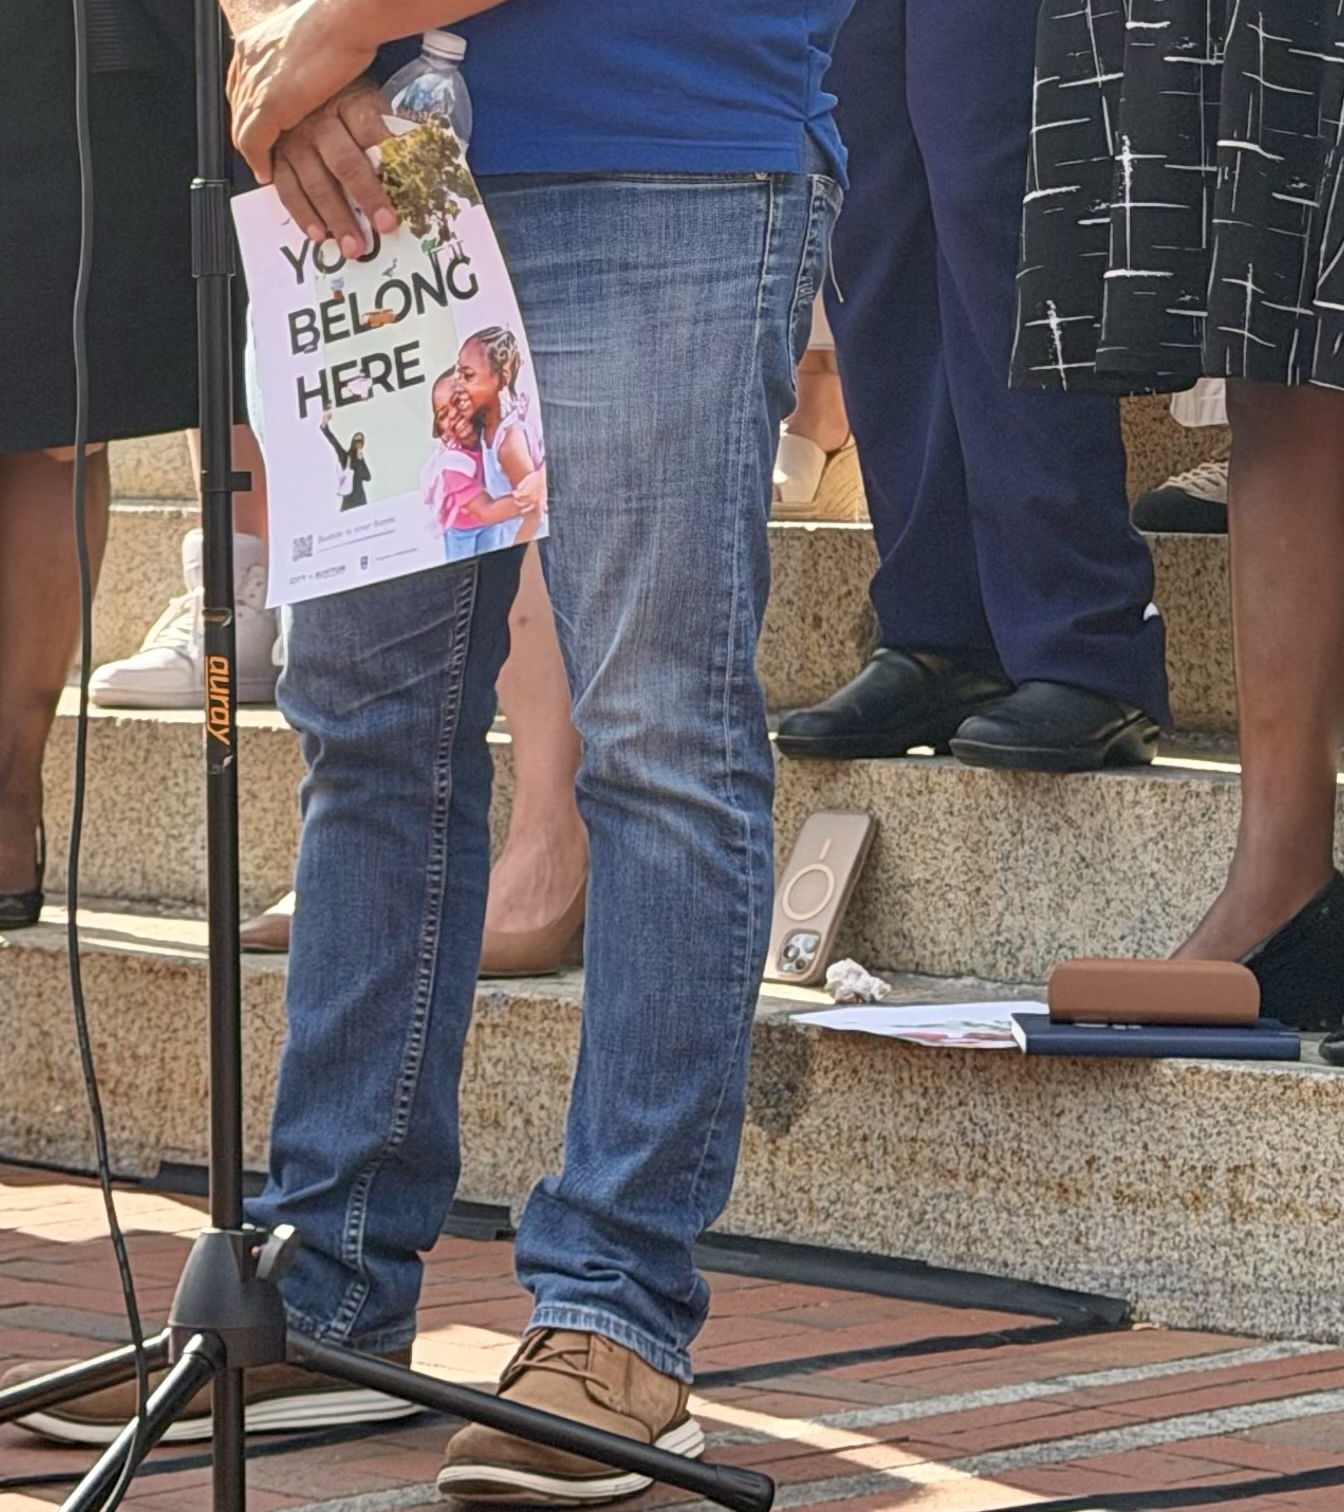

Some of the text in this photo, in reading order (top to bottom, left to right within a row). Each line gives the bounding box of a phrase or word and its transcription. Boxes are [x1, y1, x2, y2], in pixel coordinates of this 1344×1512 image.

[280, 231, 381, 285] YOU
[288, 252, 479, 355] BELONG
[296, 340, 426, 419] HERE
